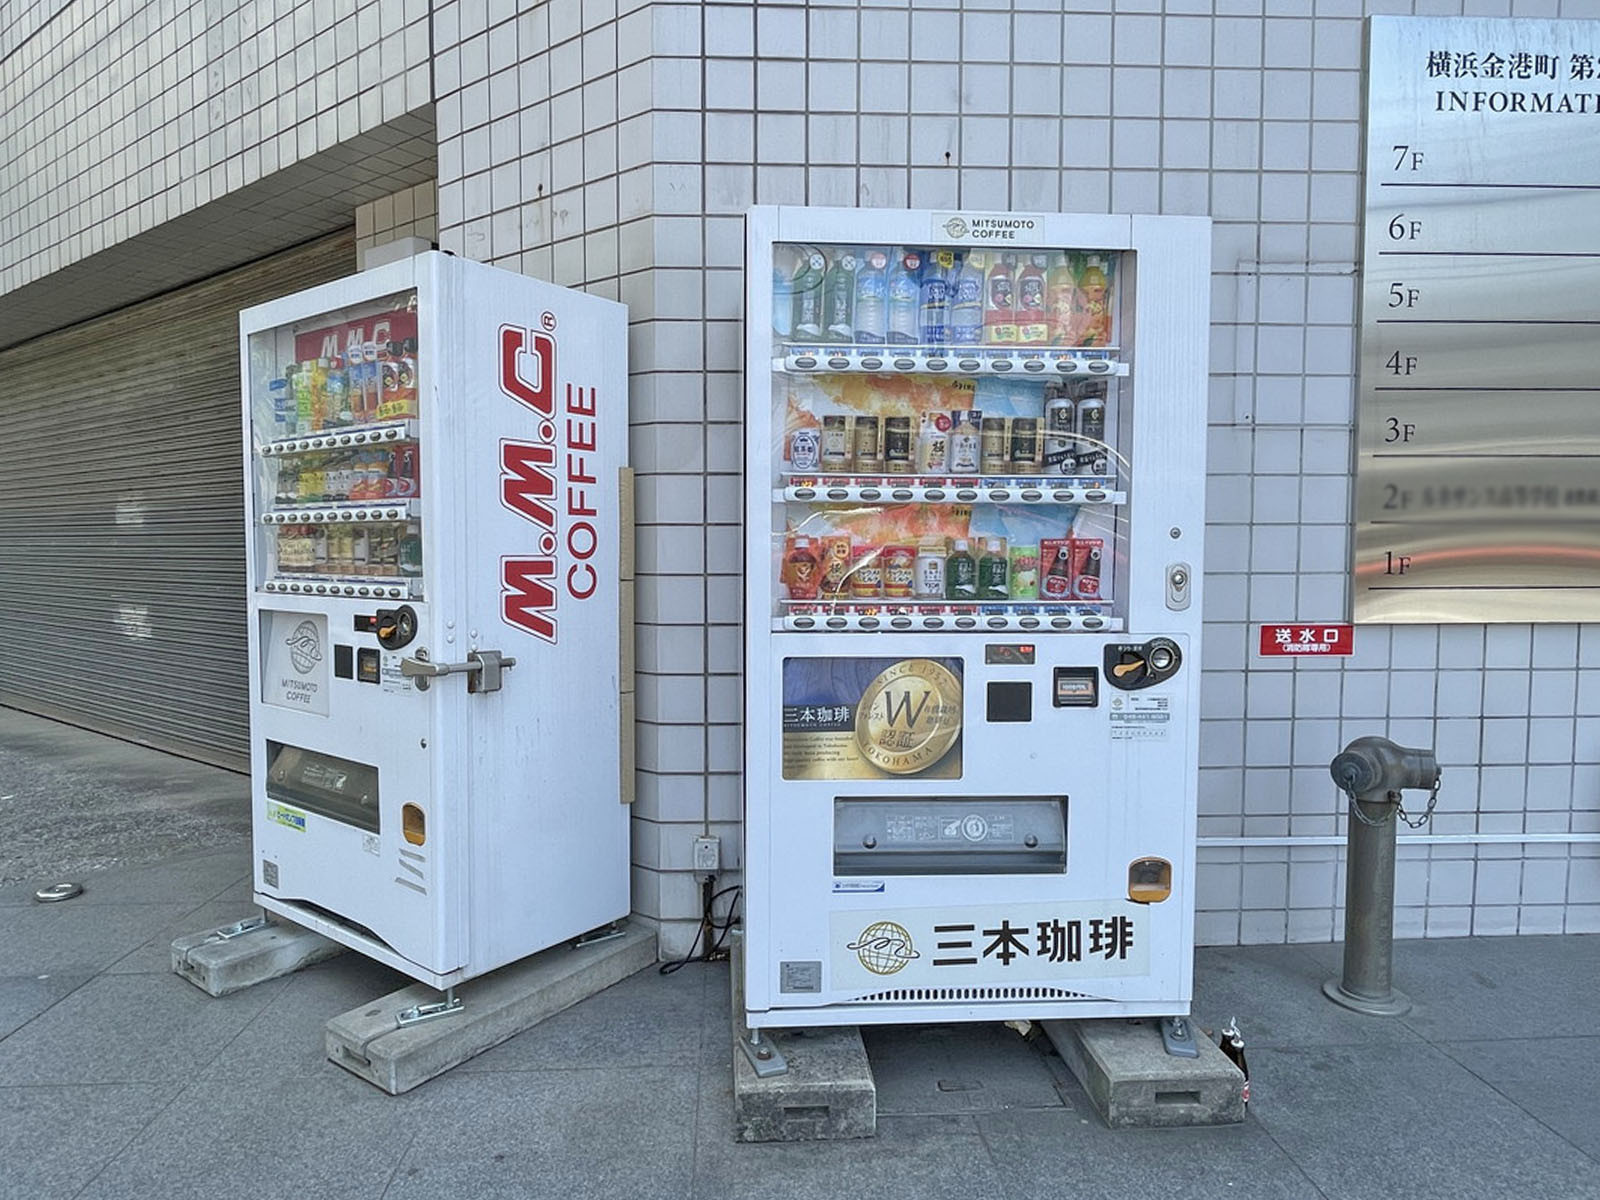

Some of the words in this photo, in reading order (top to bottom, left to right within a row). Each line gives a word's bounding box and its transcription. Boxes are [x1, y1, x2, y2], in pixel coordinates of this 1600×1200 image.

[1425, 51, 1559, 80] 横浜金港町
[1569, 53, 1600, 80] 第
[1392, 145, 1424, 171] 7F
[972, 219, 1035, 229] MITSUMOTO
[972, 230, 1015, 239] COFFEE
[1389, 214, 1422, 240] 6F
[1388, 283, 1420, 308] 5F
[1385, 350, 1418, 375] 4F
[1385, 417, 1416, 442] 3F
[566, 383, 598, 600] COFFEE
[1384, 551, 1411, 575] 1F
[1275, 628, 1338, 643] 送水口
[281, 678, 318, 692] MITSUMOTO
[286, 691, 311, 703] COFFEE
[784, 706, 850, 722] 三本珈琲
[885, 691, 931, 729] W
[863, 742, 933, 766] YOKOHAMA
[933, 916, 1134, 966] 三本珈琲
